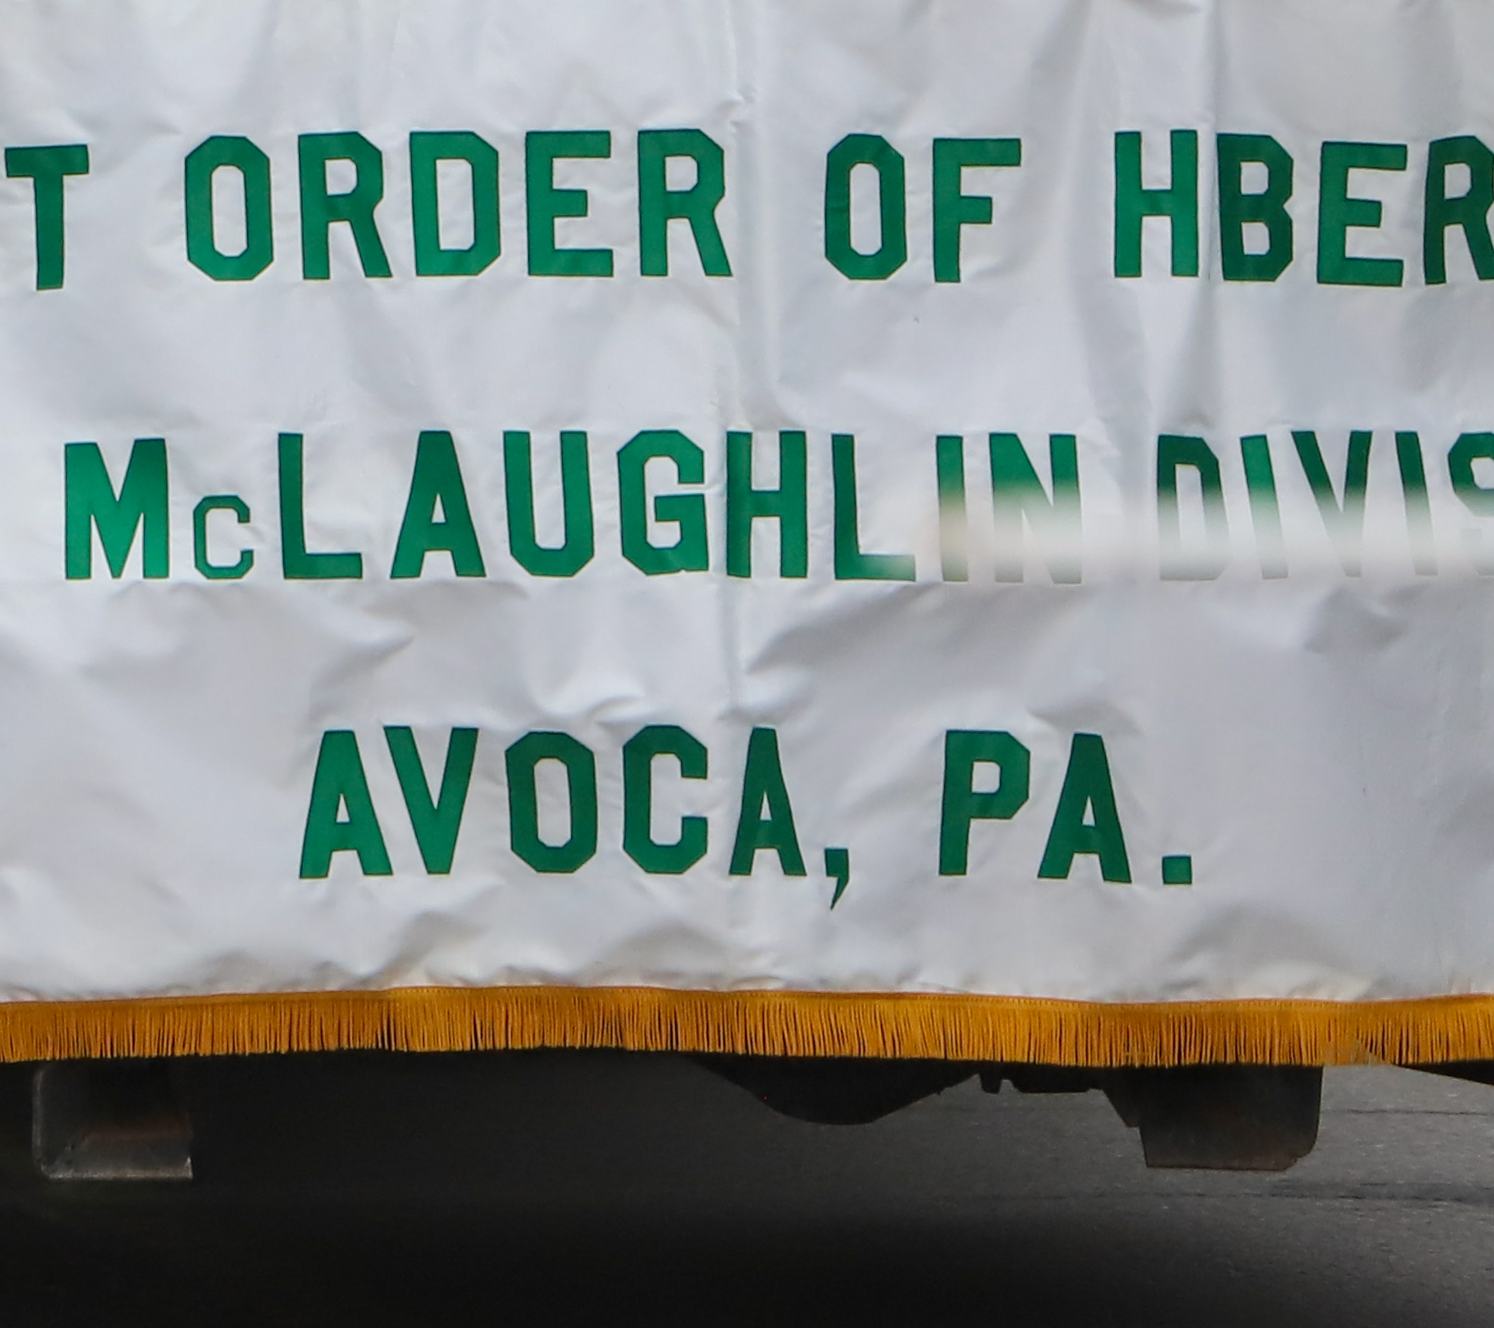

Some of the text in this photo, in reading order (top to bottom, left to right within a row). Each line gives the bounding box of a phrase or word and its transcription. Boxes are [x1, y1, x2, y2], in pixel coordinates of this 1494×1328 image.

[182, 128, 734, 282] ORDER
[822, 133, 1023, 284] OF
[1112, 127, 1494, 288] HBER
[62, 429, 1081, 585] McLAUGHLIN
[298, 724, 1194, 909] AVOCA, PA.
